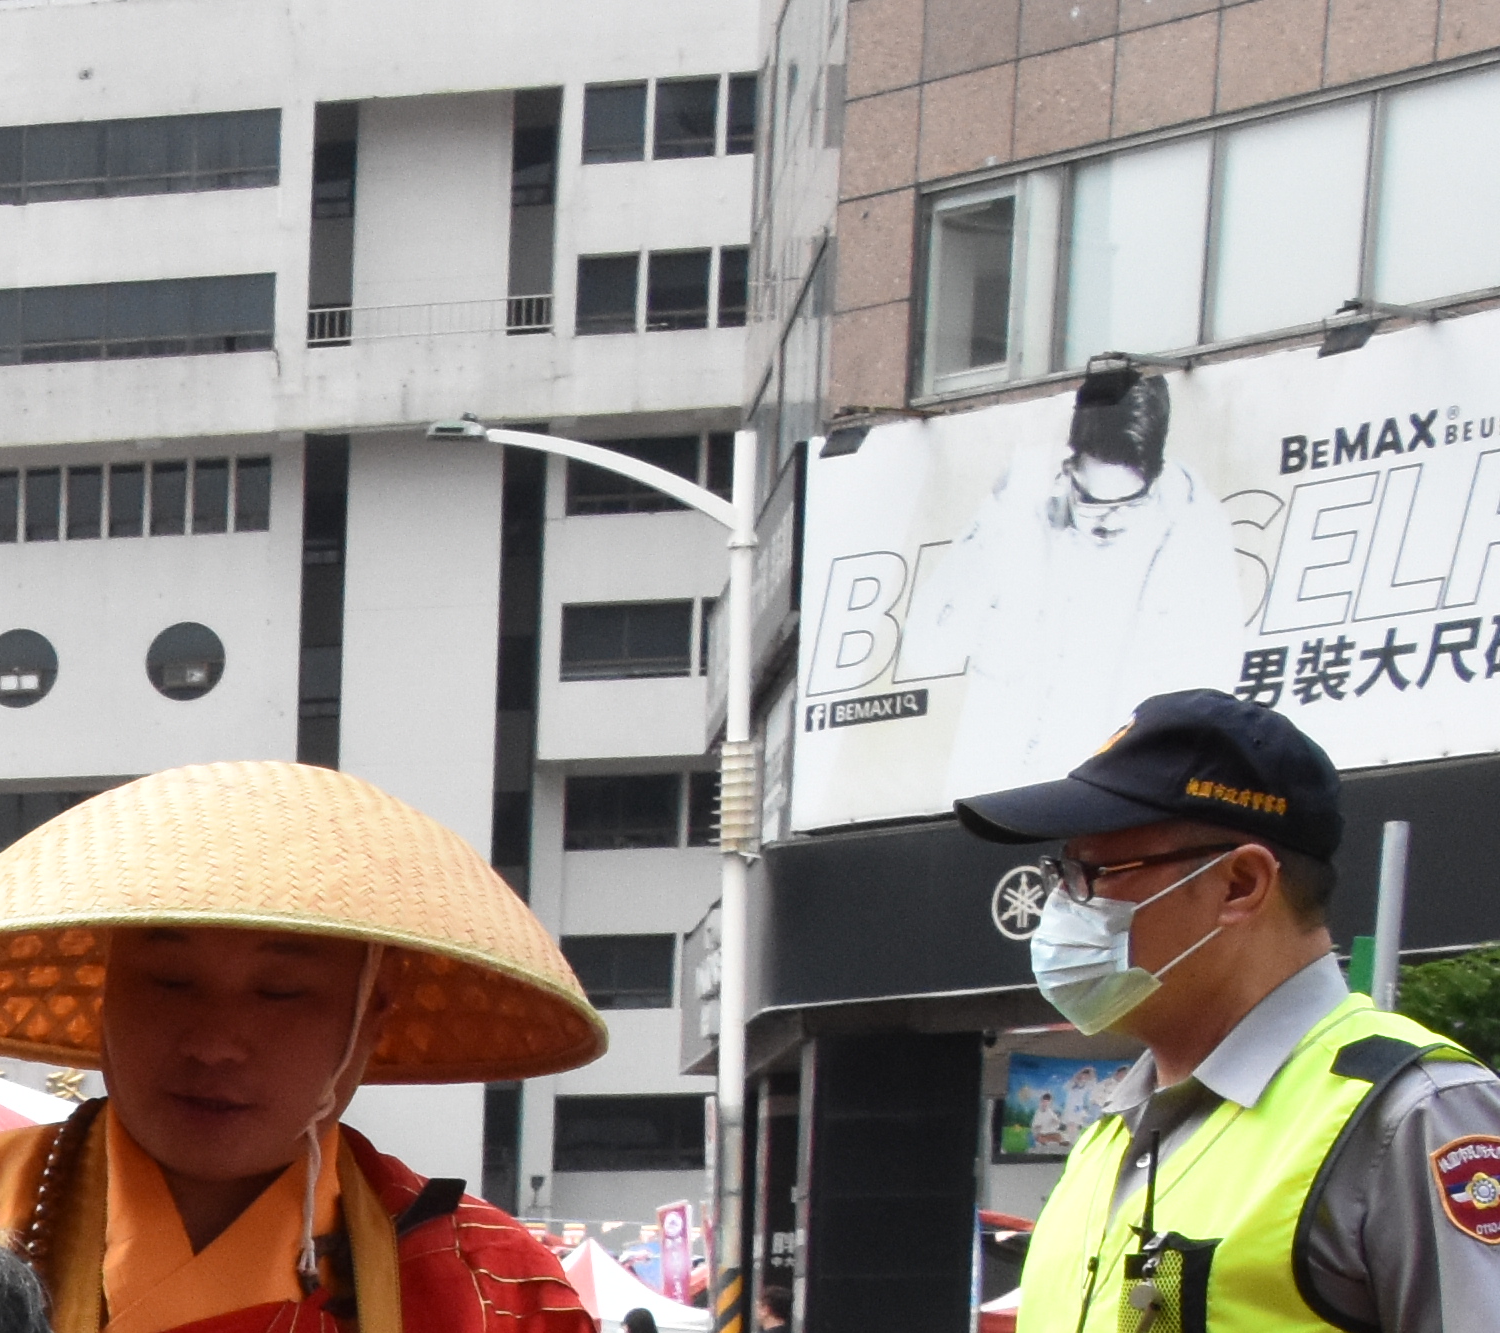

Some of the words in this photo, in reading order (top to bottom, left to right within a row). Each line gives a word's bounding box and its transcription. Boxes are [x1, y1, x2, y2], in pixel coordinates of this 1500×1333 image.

[1479, 415, 1500, 439] U
[1234, 615, 1500, 709] 男裝大尺
[835, 699, 893, 723] BEMAX
